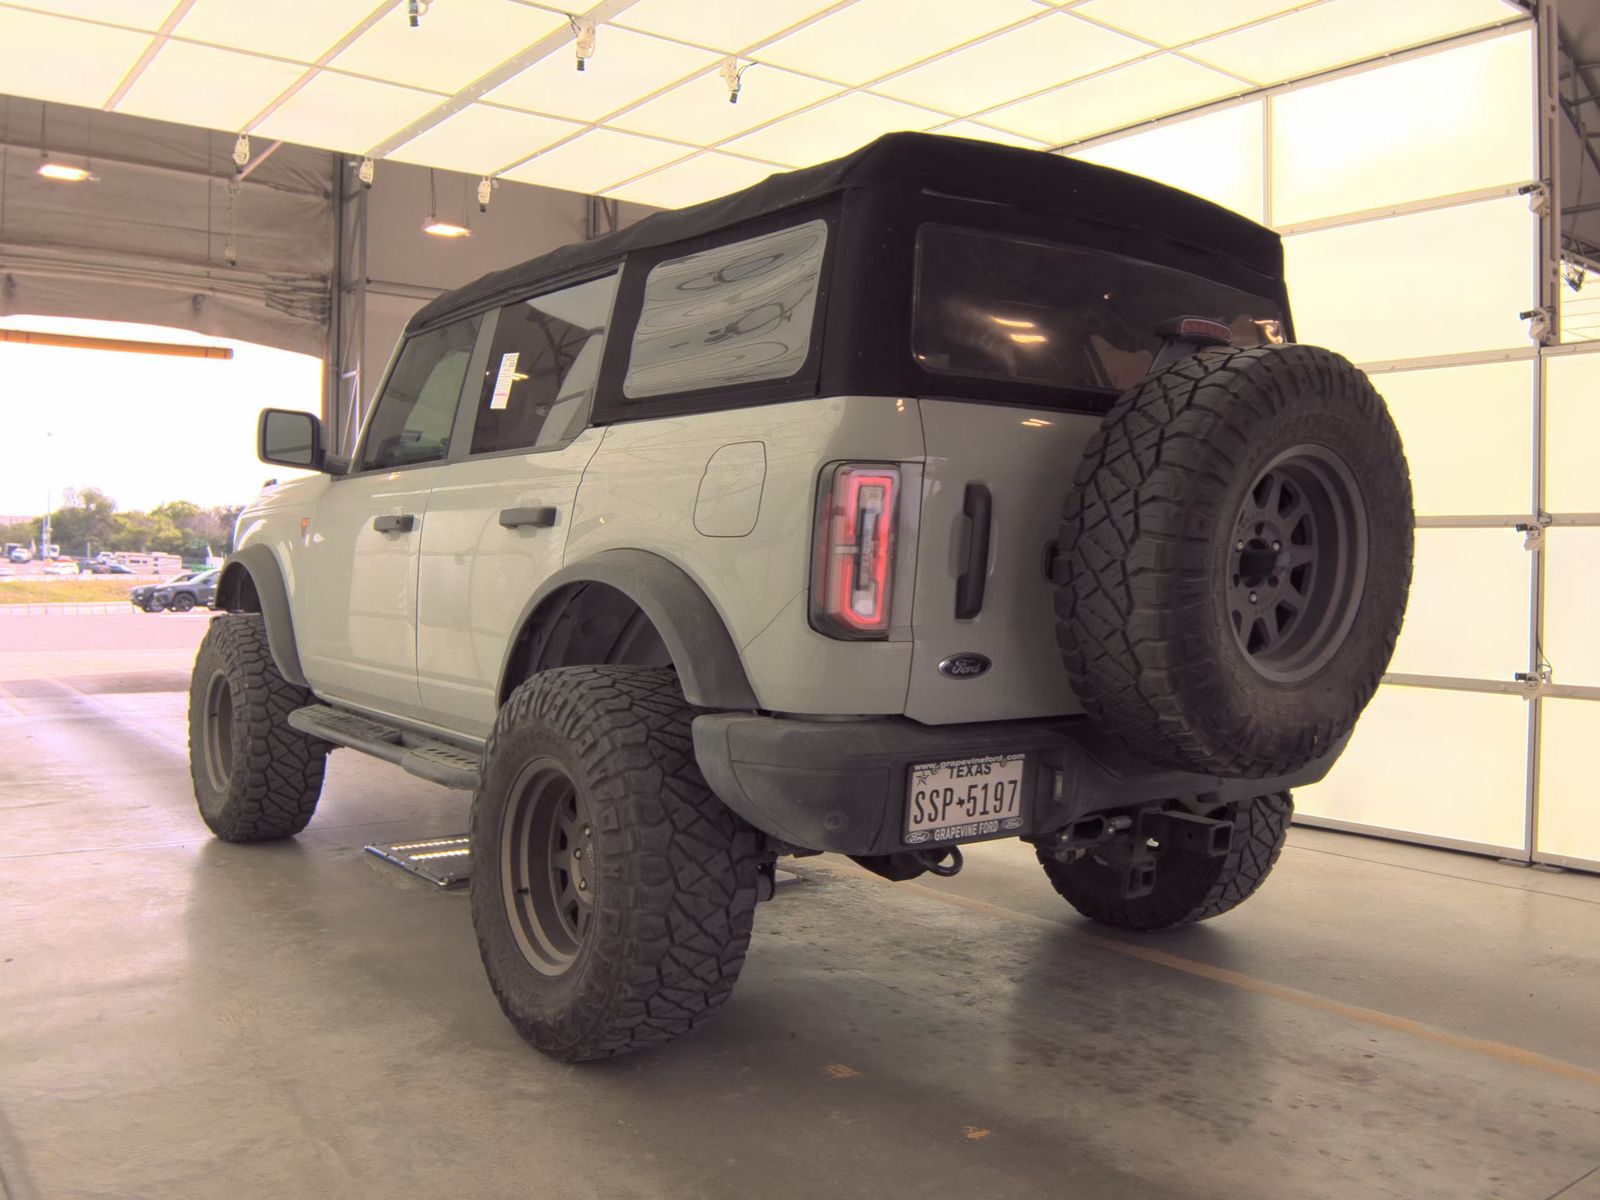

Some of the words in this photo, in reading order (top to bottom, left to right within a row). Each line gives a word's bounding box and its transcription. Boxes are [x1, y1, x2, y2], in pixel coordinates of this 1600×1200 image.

[952, 660, 981, 674] Ford
[947, 763, 992, 779] TEXAS
[934, 825, 977, 841] GRAPEVINE
[980, 821, 999, 834] FORD
